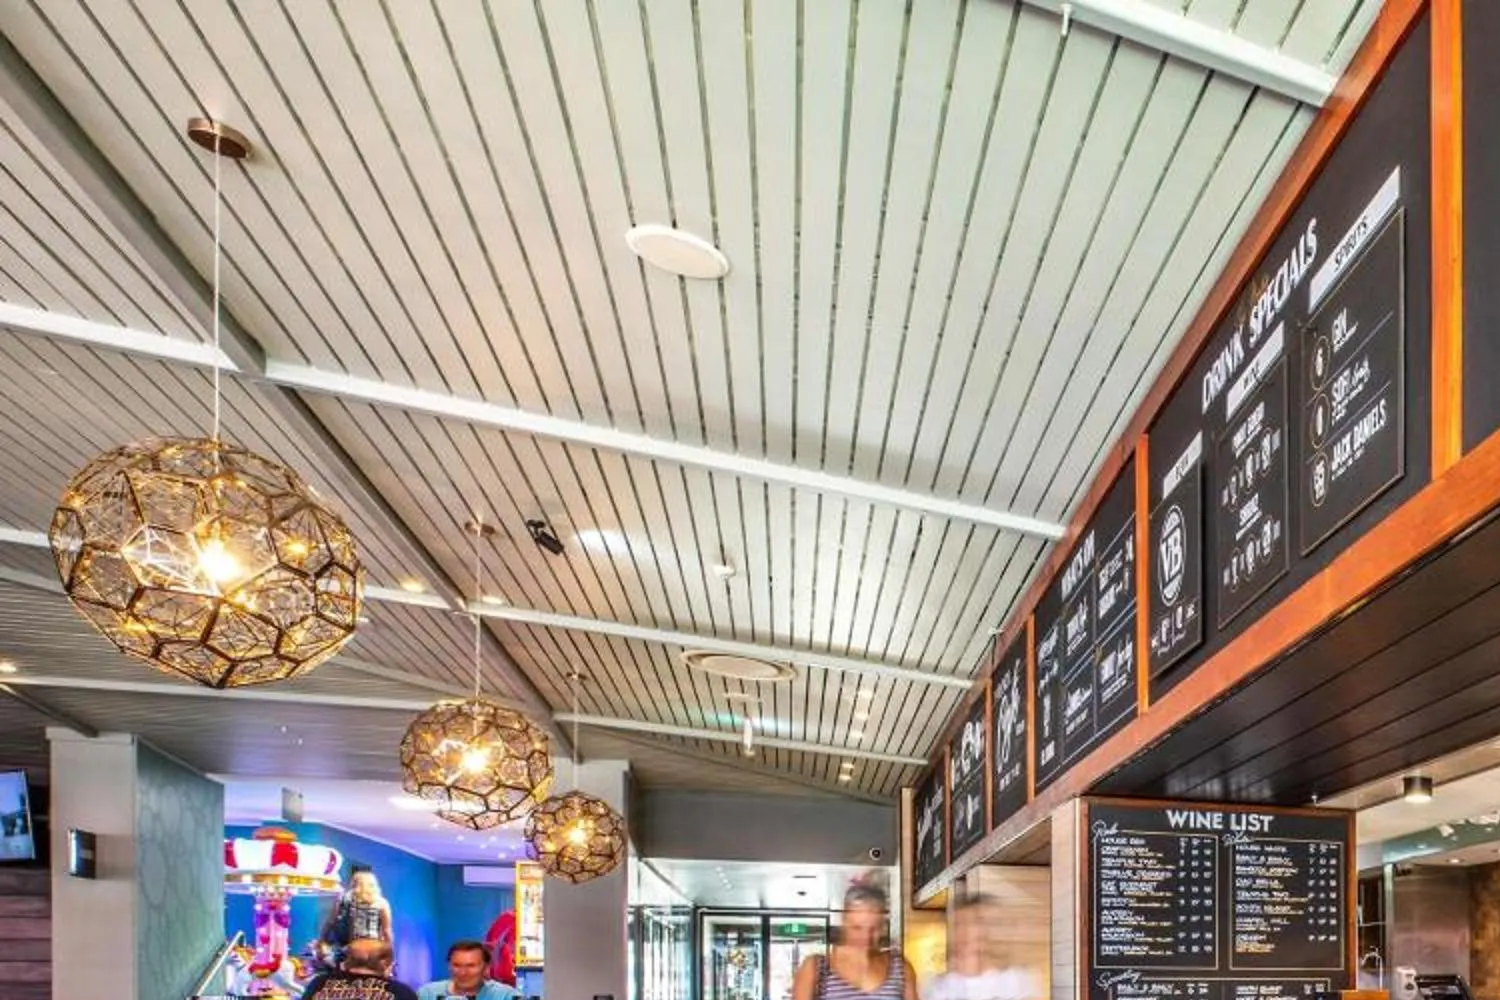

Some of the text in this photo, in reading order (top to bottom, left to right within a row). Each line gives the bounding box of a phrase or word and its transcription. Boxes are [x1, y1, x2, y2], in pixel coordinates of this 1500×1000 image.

[1335, 216, 1368, 273] SPIRITS
[1202, 217, 1318, 415] DRINK SPECIALS
[1160, 530, 1183, 583] VB
[1166, 810, 1275, 832] WINE LIST
